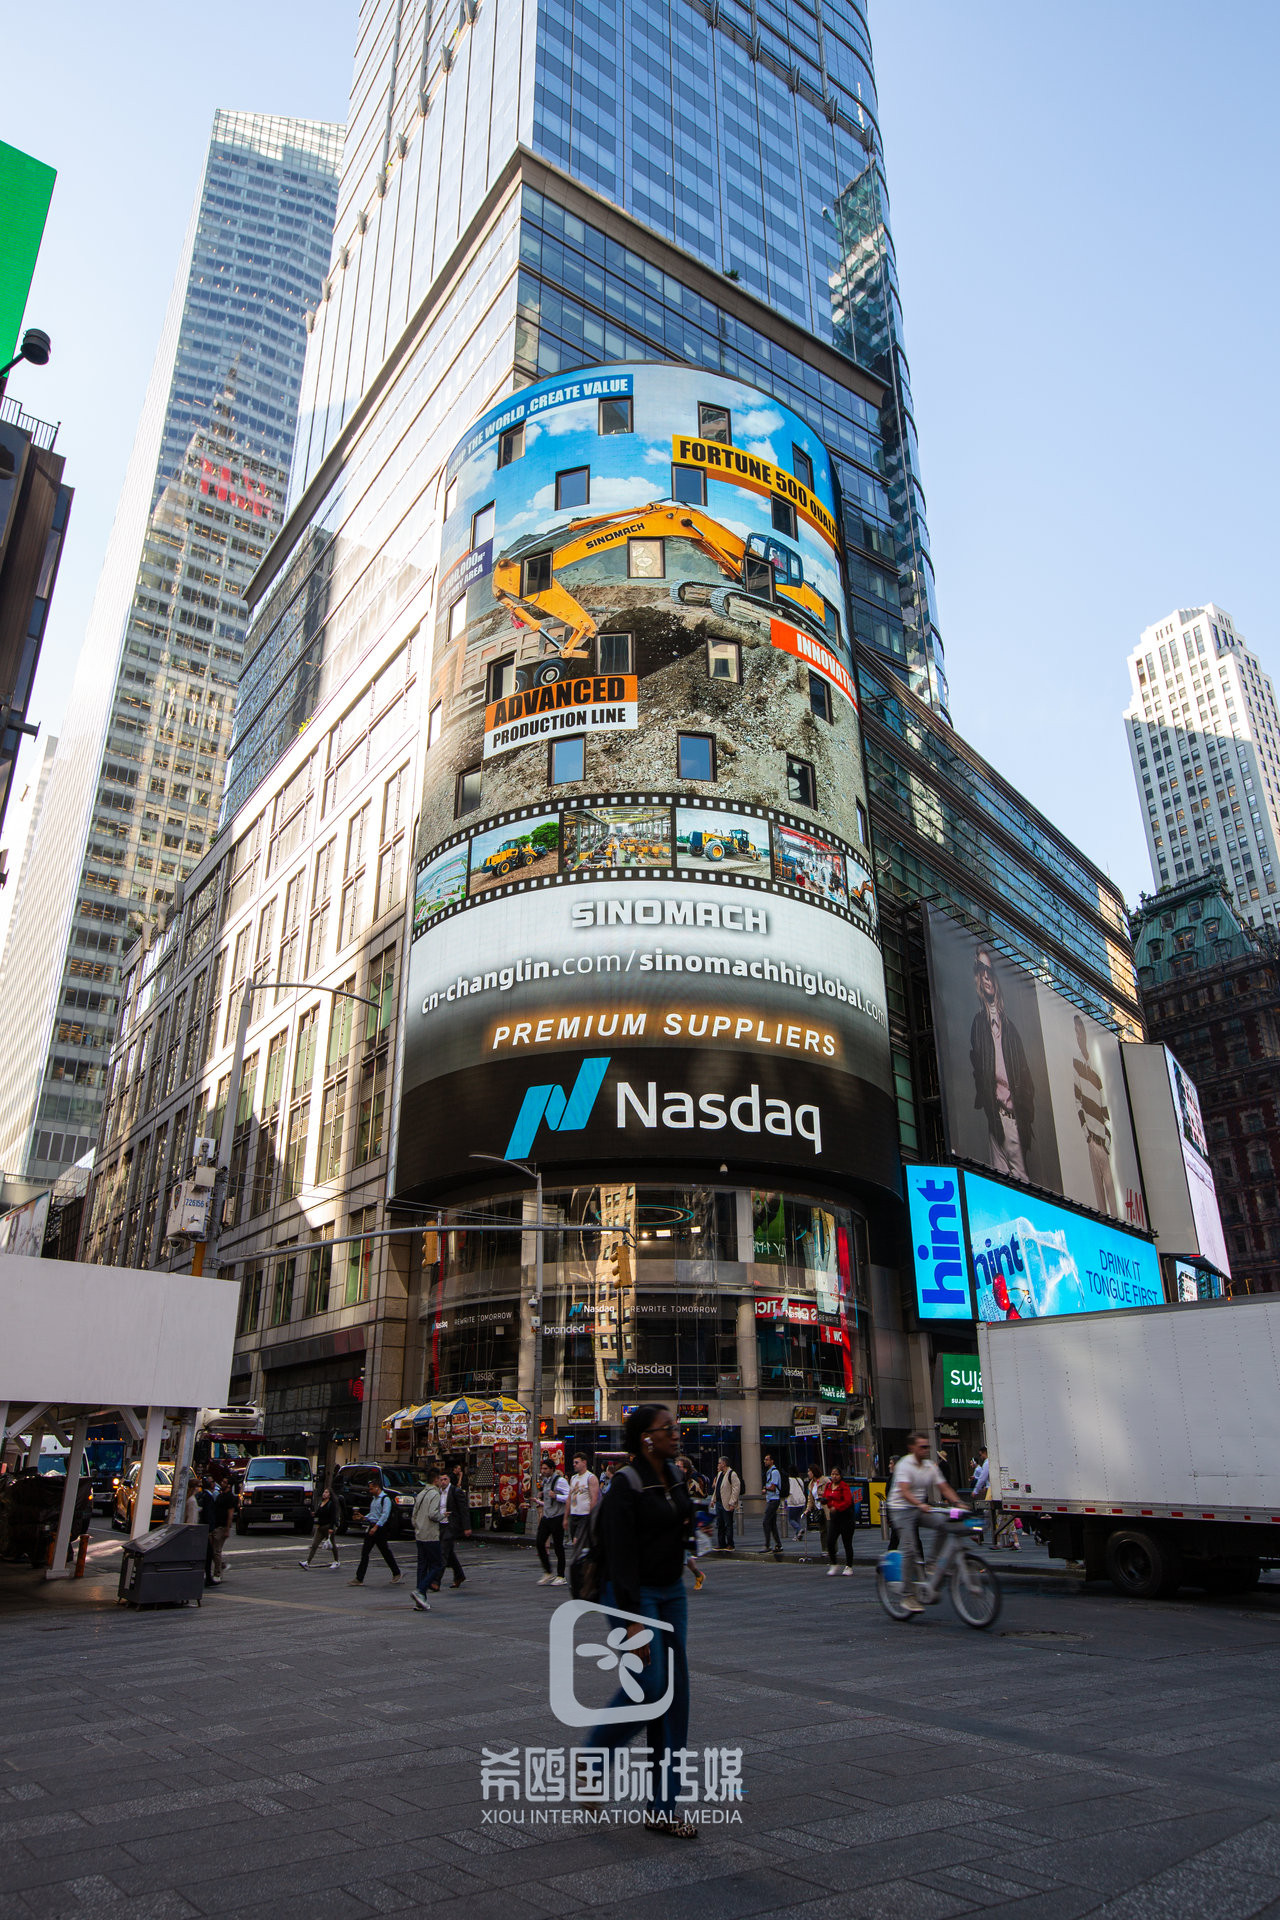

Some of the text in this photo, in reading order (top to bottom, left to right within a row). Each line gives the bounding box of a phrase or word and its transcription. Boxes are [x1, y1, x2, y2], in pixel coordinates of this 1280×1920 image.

[485, 404, 525, 441] WORLD
[583, 378, 628, 396] VALUE
[679, 440, 772, 485] FORTUNE
[775, 470, 808, 508] 500
[585, 522, 646, 549] SINOMACH
[493, 677, 625, 728] ADVANCED
[493, 708, 626, 749] PRODUCTION LINE
[571, 900, 767, 935] SINOMACH
[492, 1013, 836, 1056] PREMIUM SUPPLIERS
[616, 1081, 822, 1155] Nasdaq
[1125, 1187, 1145, 1228] H&M
[916, 1179, 966, 1305] hint
[1099, 1249, 1141, 1282] DRINK IT
[1086, 1270, 1158, 1306] TONGUE FIRST
[477, 1311, 513, 1323] TOMORROW
[584, 1305, 718, 1315] Nasdaq REWRITE TOMORROW
[628, 1362, 673, 1377] Nasdaq
